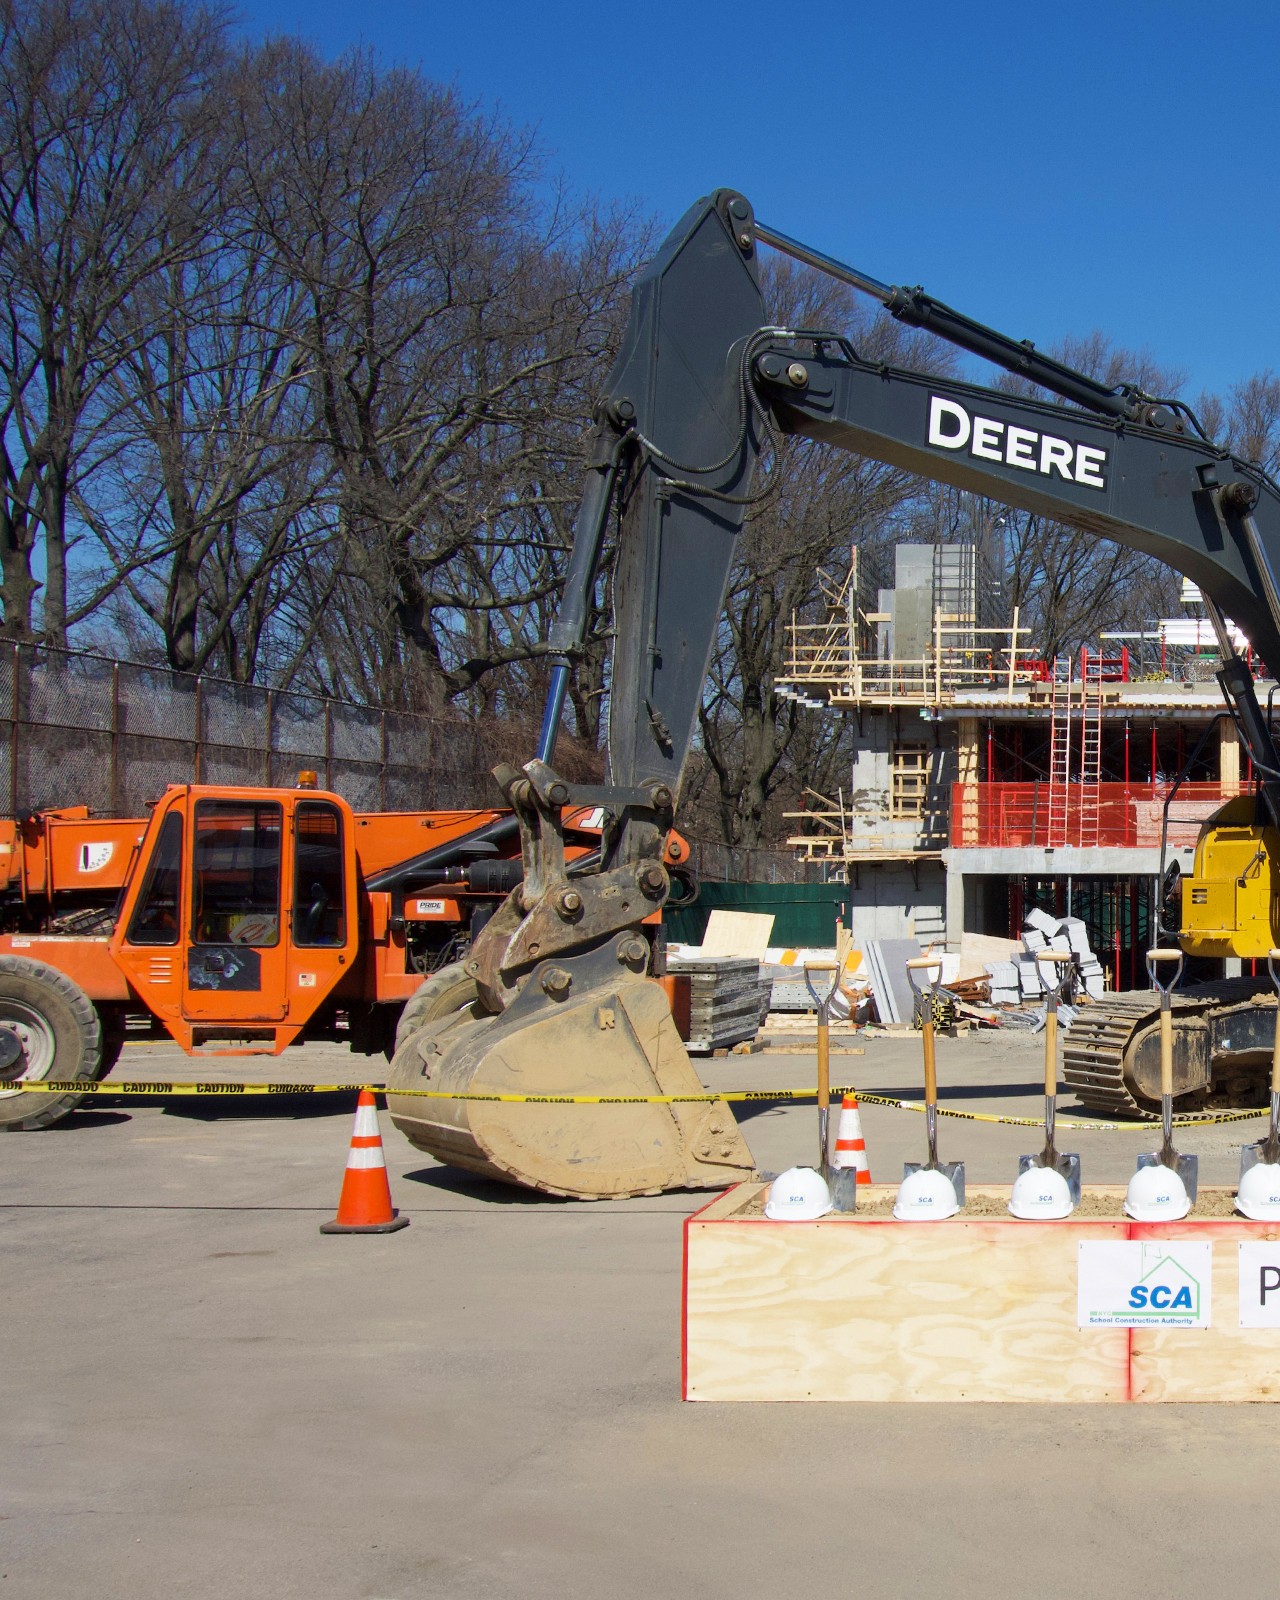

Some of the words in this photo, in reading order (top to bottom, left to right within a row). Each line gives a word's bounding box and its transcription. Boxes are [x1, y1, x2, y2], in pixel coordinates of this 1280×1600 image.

[928, 395, 1106, 488] DEERE
[48, 1082, 99, 1092] CUIDADO
[123, 1083, 173, 1093] CAUTION
[196, 1084, 245, 1093] CAUTION
[1128, 1285, 1193, 1309] SCA
[1161, 1317, 1193, 1325] Authority
